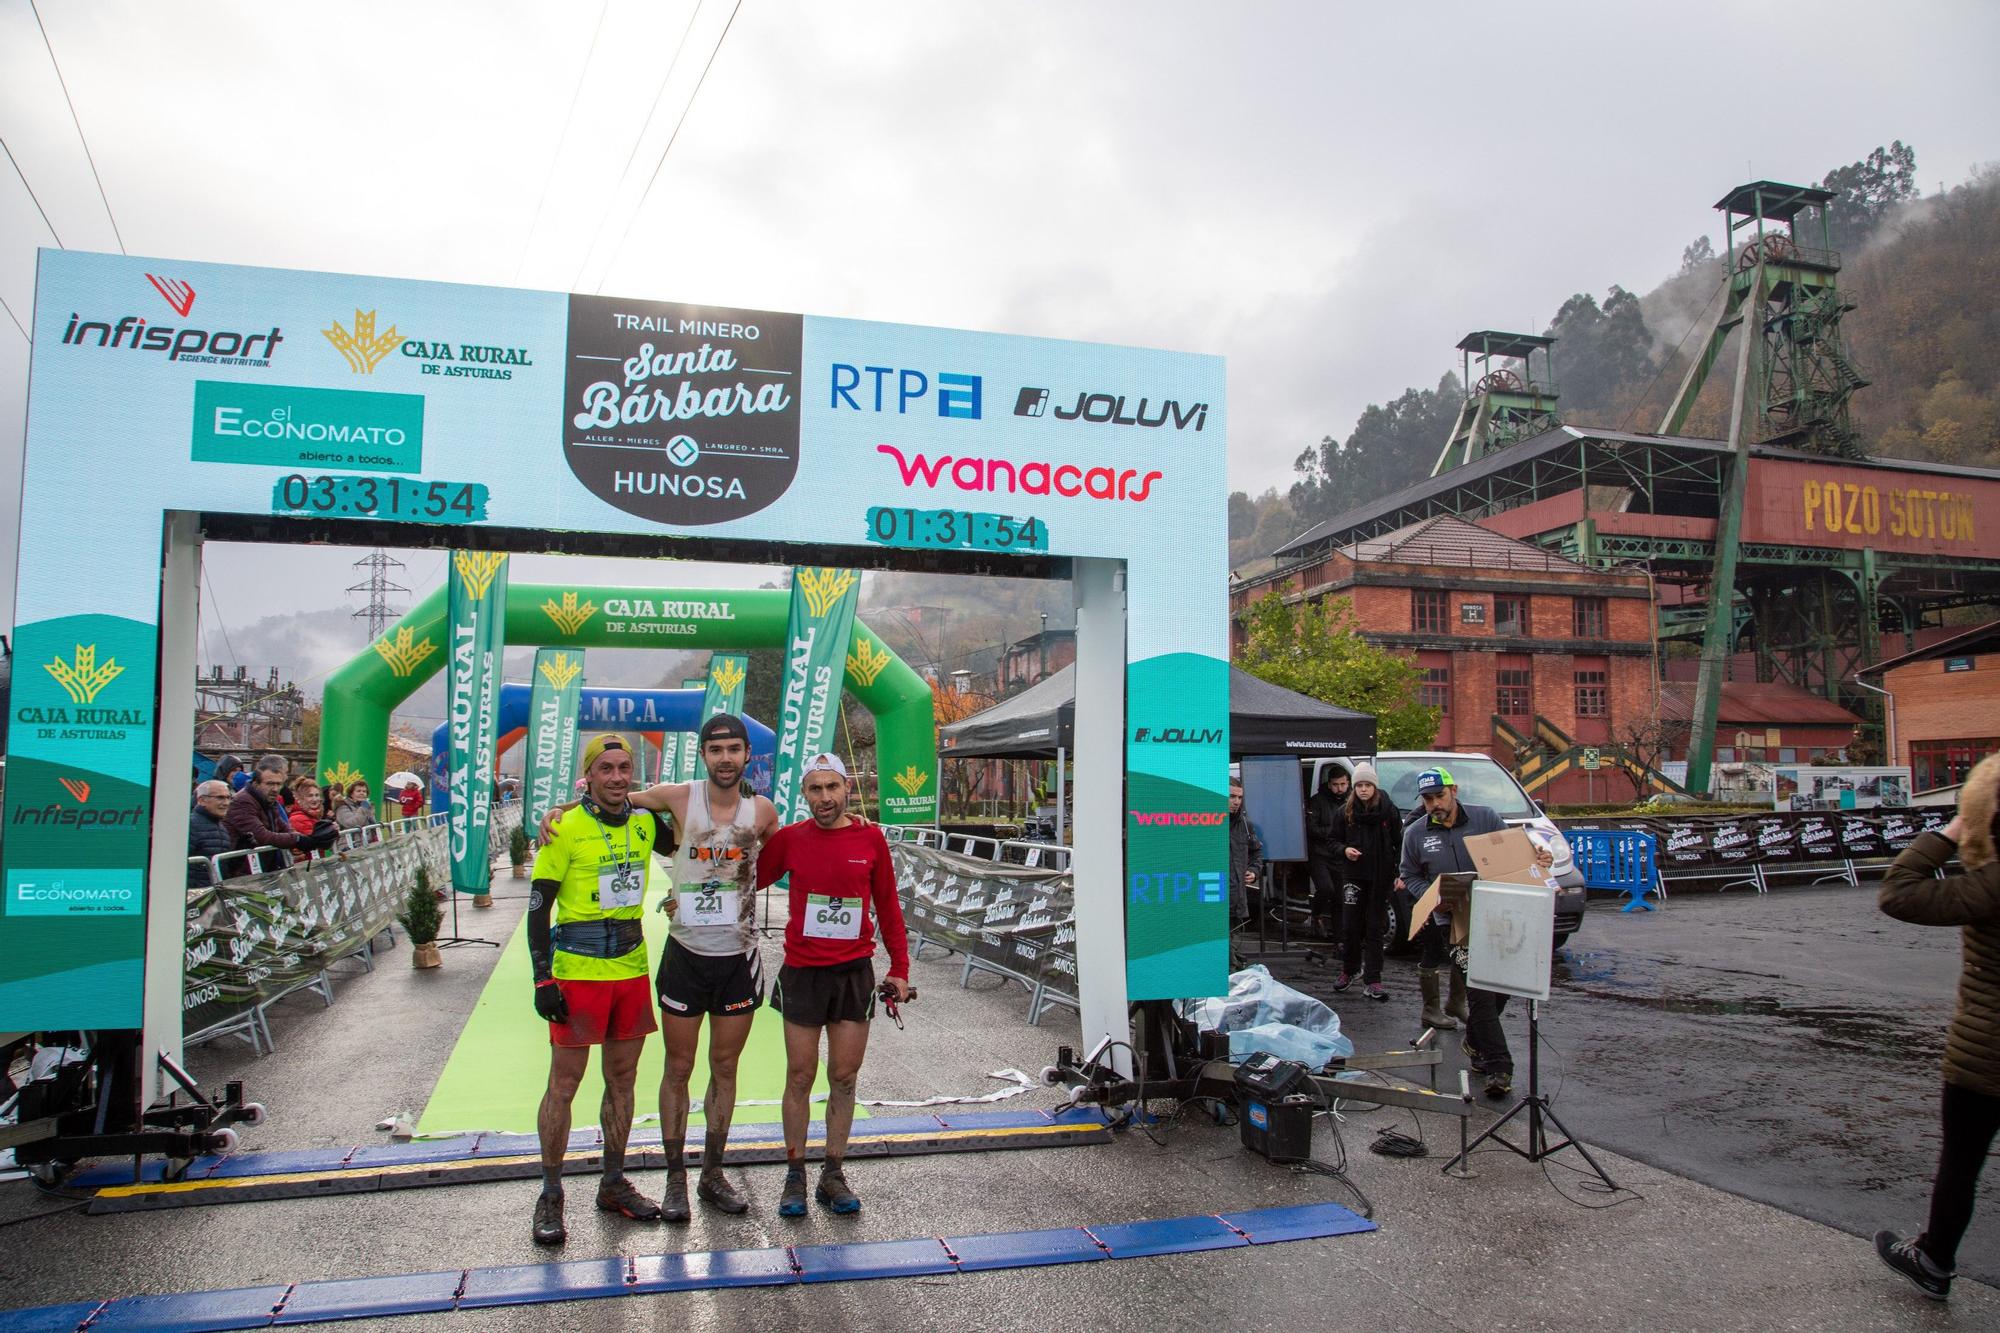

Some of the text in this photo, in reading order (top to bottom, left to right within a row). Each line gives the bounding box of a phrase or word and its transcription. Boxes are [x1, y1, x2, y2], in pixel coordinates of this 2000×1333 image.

[62, 312, 284, 361] infisport
[614, 313, 760, 340] TRAIL MINERO
[179, 354, 219, 364] SCIENCE
[401, 341, 532, 366] CAJA RURAL
[624, 342, 738, 387] Santa
[421, 364, 512, 380] DE ASTURIAS
[271, 406, 291, 421] el
[573, 380, 791, 430] Bárbara
[214, 407, 405, 446] ECONOMATO
[627, 438, 660, 446] MIERES
[705, 443, 748, 451] LANGREO
[299, 452, 342, 462] abierto
[358, 455, 403, 466] todos...
[614, 471, 746, 500] HUNOSA
[877, 444, 1162, 502] wanacars
[283, 474, 475, 518] 03:31:54
[1803, 480, 1881, 536] POZO
[875, 507, 1039, 547] 01:31:54
[604, 599, 736, 620] CAJA RURAL
[606, 622, 698, 635] DE ASTURIAS
[780, 627, 816, 758] RURAL
[18, 708, 146, 725] CAJA RURAL
[38, 728, 126, 740] DE ASTURIAS
[452, 612, 477, 862] CAJA RURAL
[473, 651, 494, 828] DE ASTURIAS
[532, 696, 560, 826] CAJA RURAL
[556, 716, 576, 782] ASTURIAS
[663, 736, 678, 776] RURAL
[886, 796, 936, 806] CAJA RURAL
[12, 804, 144, 830] infisport
[18, 883, 132, 901] ECONOMATO
[611, 876, 640, 893] 643
[694, 896, 722, 910] 221
[816, 910, 851, 926] 640
[1052, 957, 1076, 976] HUNOS
